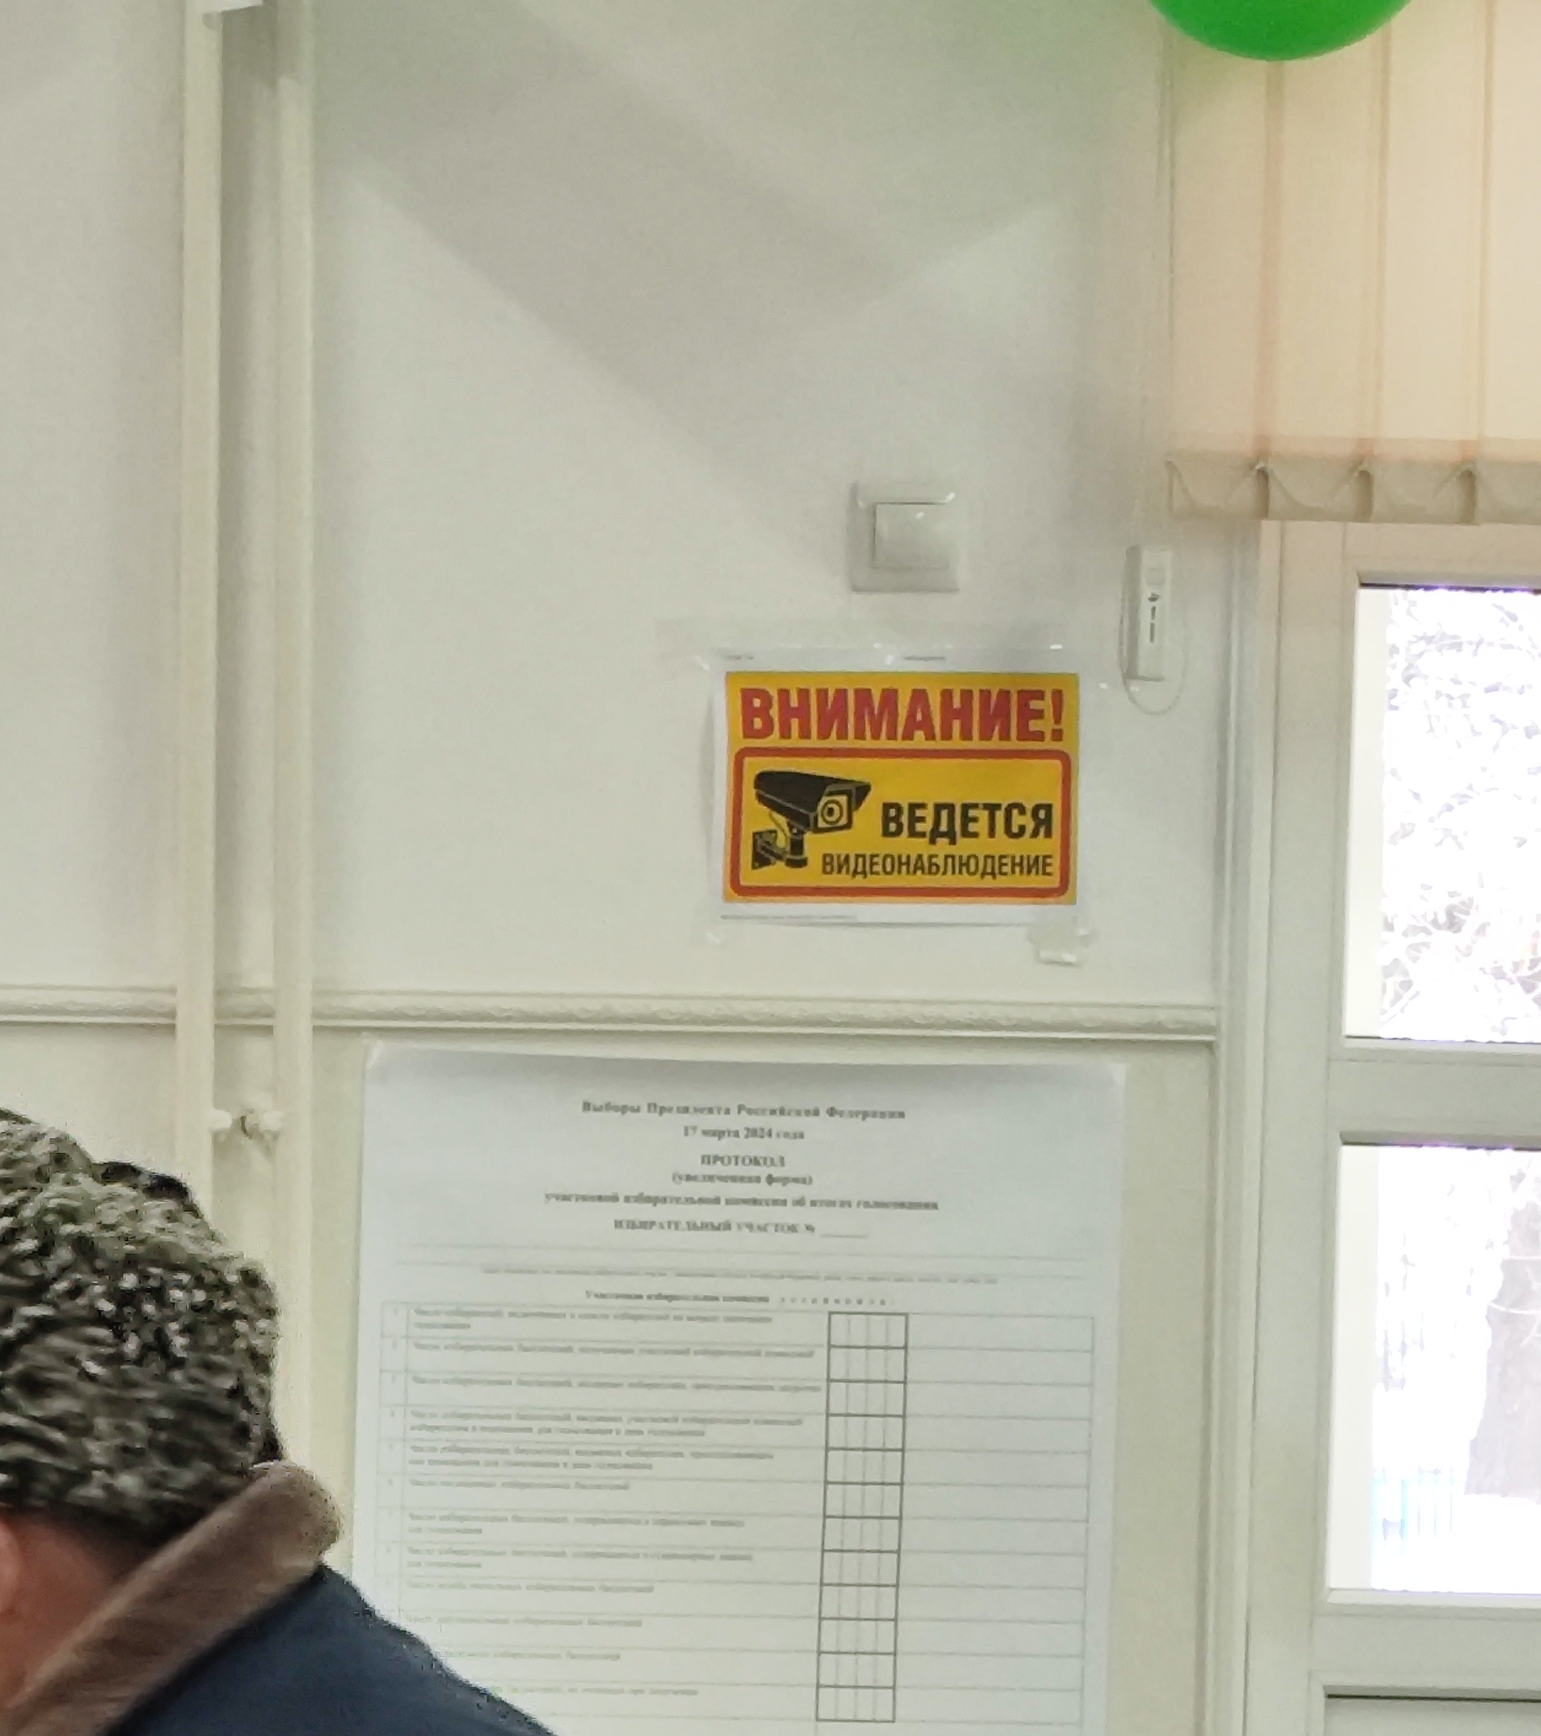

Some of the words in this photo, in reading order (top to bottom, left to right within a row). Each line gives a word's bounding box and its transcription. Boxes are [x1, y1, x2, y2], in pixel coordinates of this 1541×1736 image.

[739, 686, 1065, 743] ВНИМАНИЕ!
[880, 800, 1054, 847] ВЕДЕТСЯ
[820, 851, 1055, 881] ВИДЕОНАБЛЮДЕНИЕ
[700, 1153, 786, 1168] ПРОТОКОЛ
